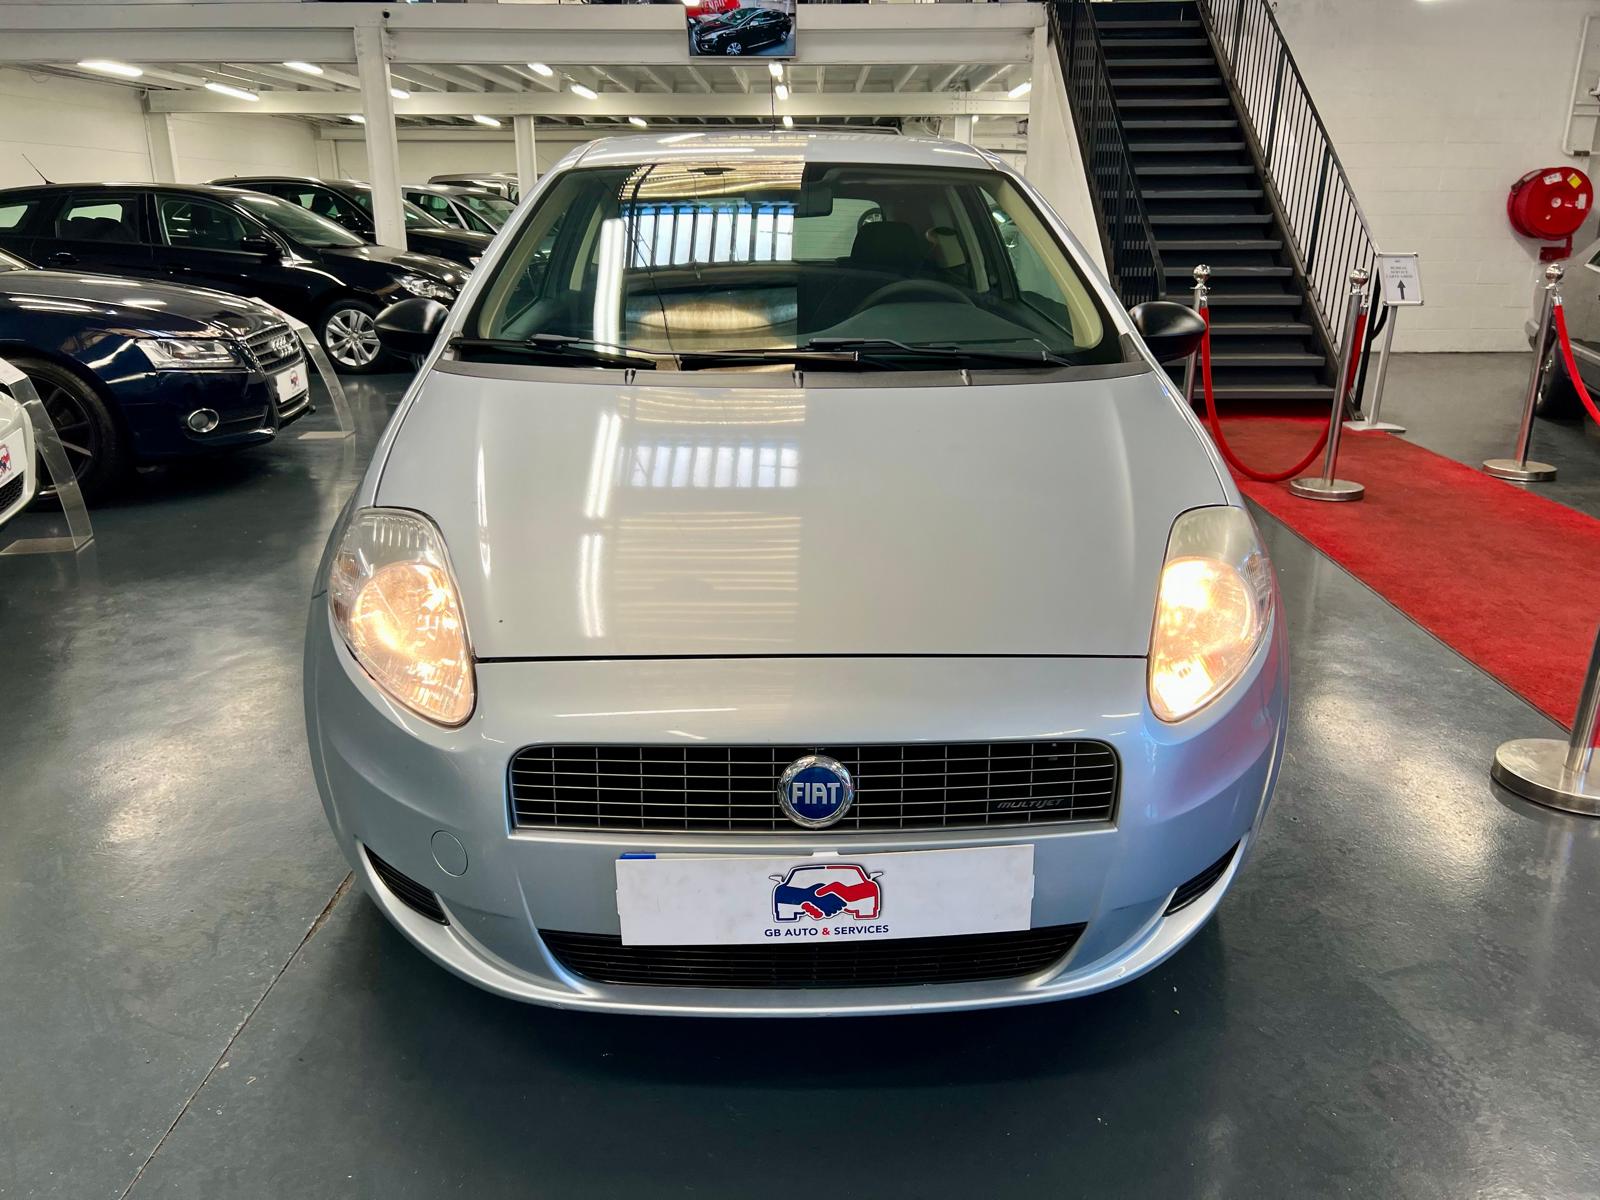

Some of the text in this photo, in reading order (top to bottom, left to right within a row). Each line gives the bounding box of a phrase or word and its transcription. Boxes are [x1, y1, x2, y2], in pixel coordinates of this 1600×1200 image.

[791, 782, 841, 805] FIAT
[764, 924, 889, 937] GB AUTO & SERVICES
